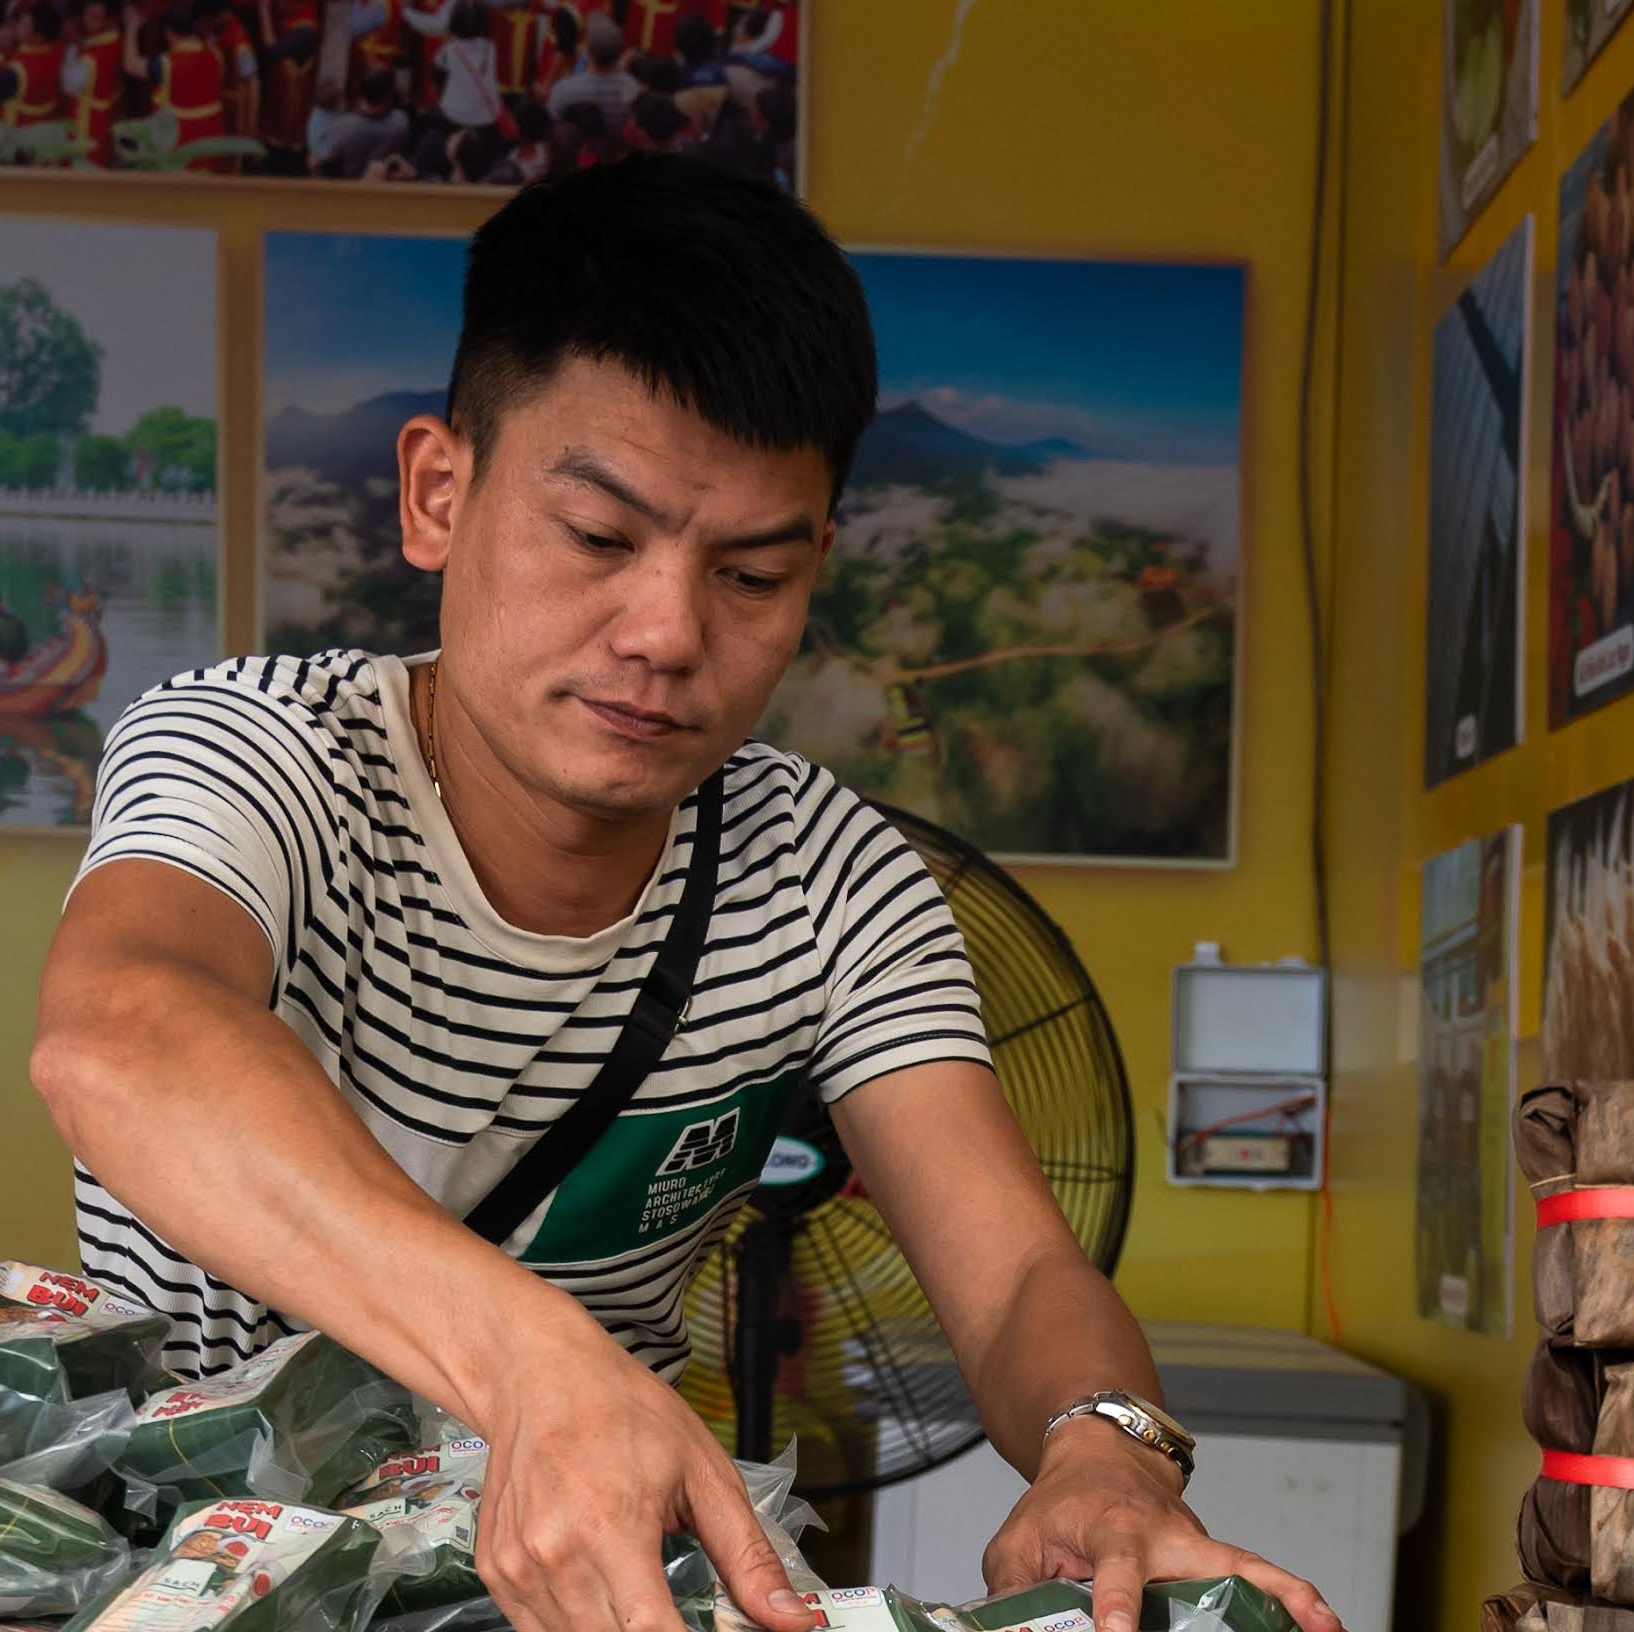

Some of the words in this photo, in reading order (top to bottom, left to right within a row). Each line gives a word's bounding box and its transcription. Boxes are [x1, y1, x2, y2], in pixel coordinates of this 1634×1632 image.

[648, 1177, 686, 1196] MIURO
[39, 1271, 101, 1304] NEM
[451, 1440, 490, 1450] OCO
[216, 1500, 285, 1520] NEM
[830, 1588, 876, 1601] OCOP
